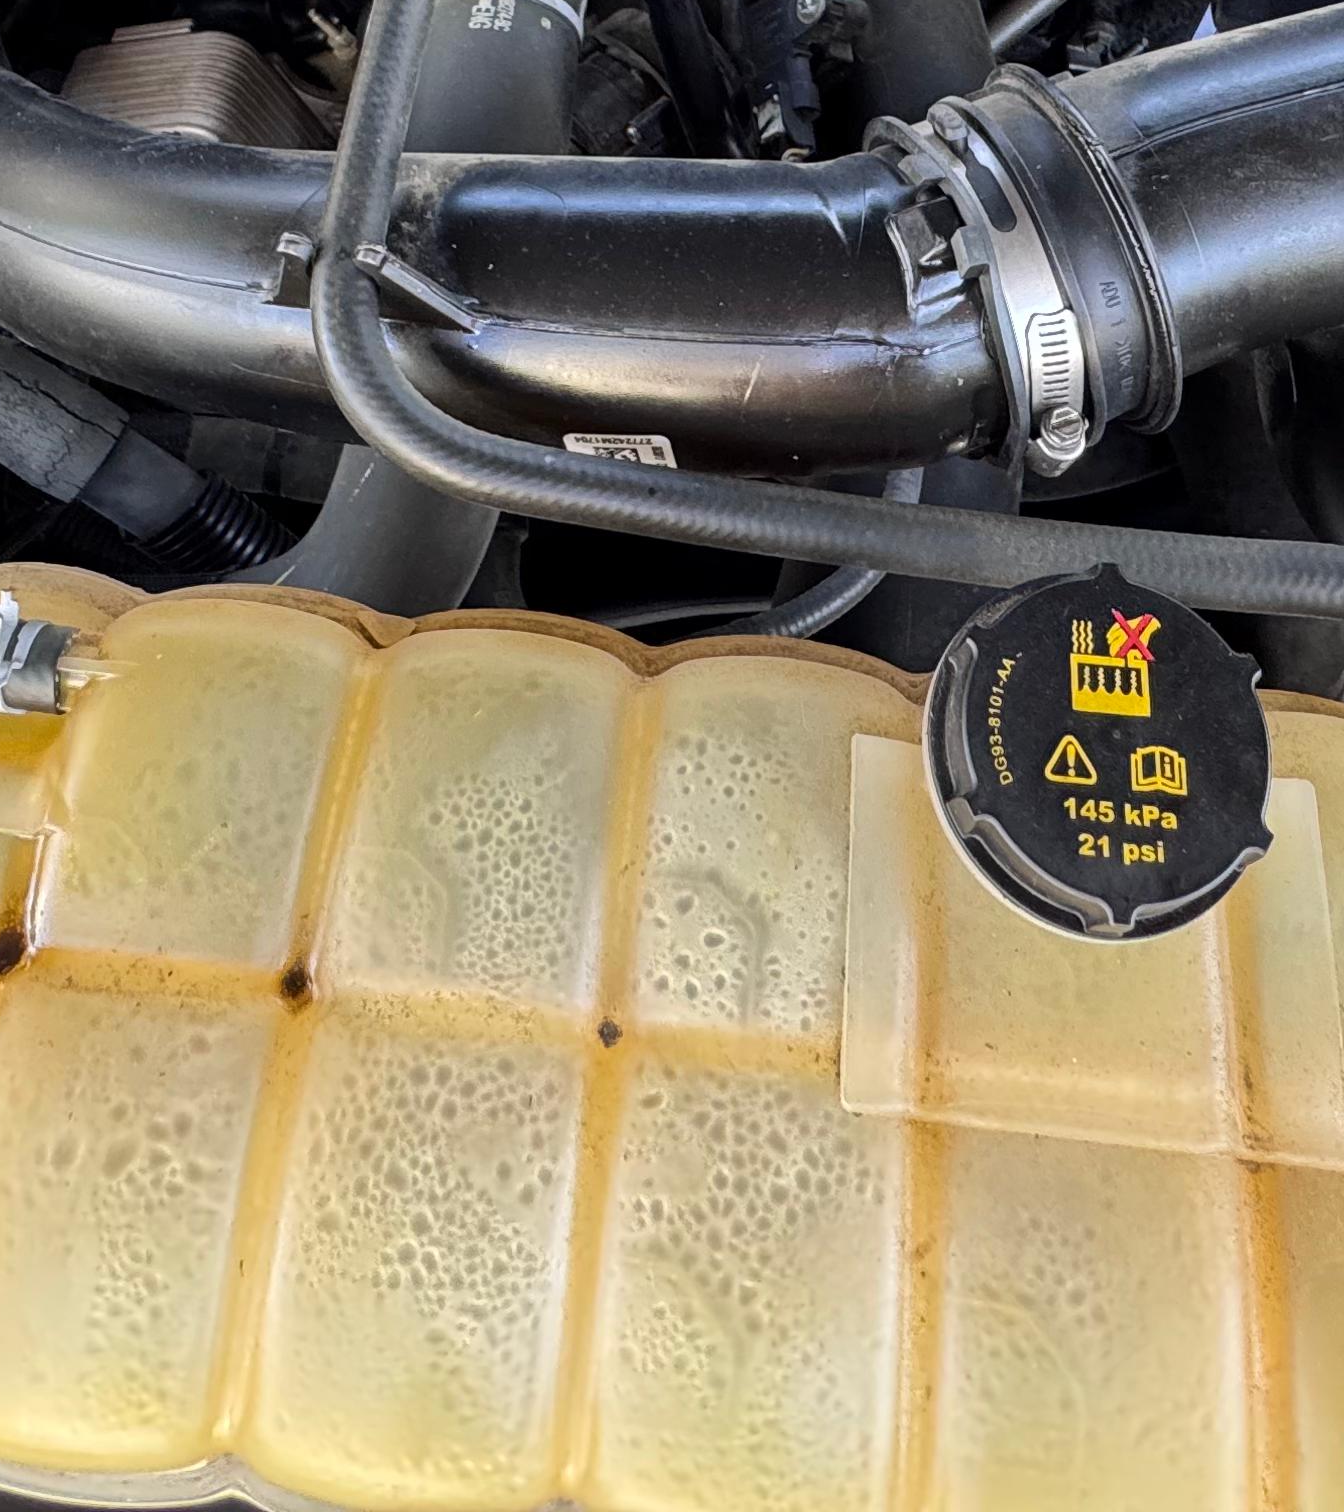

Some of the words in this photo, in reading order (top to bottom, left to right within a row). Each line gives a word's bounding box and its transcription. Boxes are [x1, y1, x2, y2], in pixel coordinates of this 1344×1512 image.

[988, 658, 1016, 785] DG93-8101-AA
[1063, 797, 1115, 823] 145
[1124, 803, 1178, 830] kPa
[1078, 834, 1110, 857] 21
[1123, 840, 1166, 865] psi
